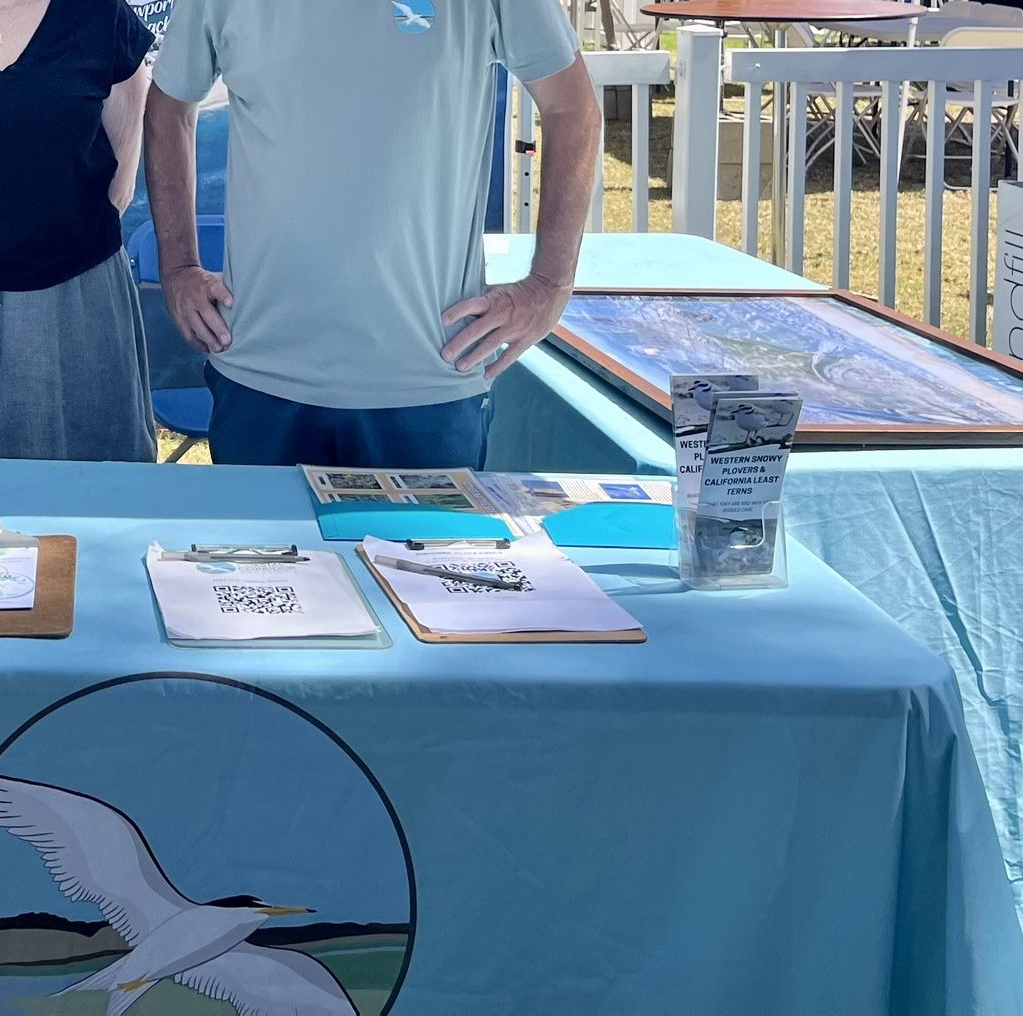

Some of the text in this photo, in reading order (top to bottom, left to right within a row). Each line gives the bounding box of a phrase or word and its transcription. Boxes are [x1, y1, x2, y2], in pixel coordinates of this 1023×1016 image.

[679, 440, 707, 449] WEST
[694, 452, 704, 461] PL
[710, 455, 783, 465] WESTERN SNOWY
[679, 465, 703, 474] CALIF
[722, 465, 766, 475] PLOVERS &
[704, 476, 752, 486] CALIFORNIA
[726, 487, 753, 495] TERNS
